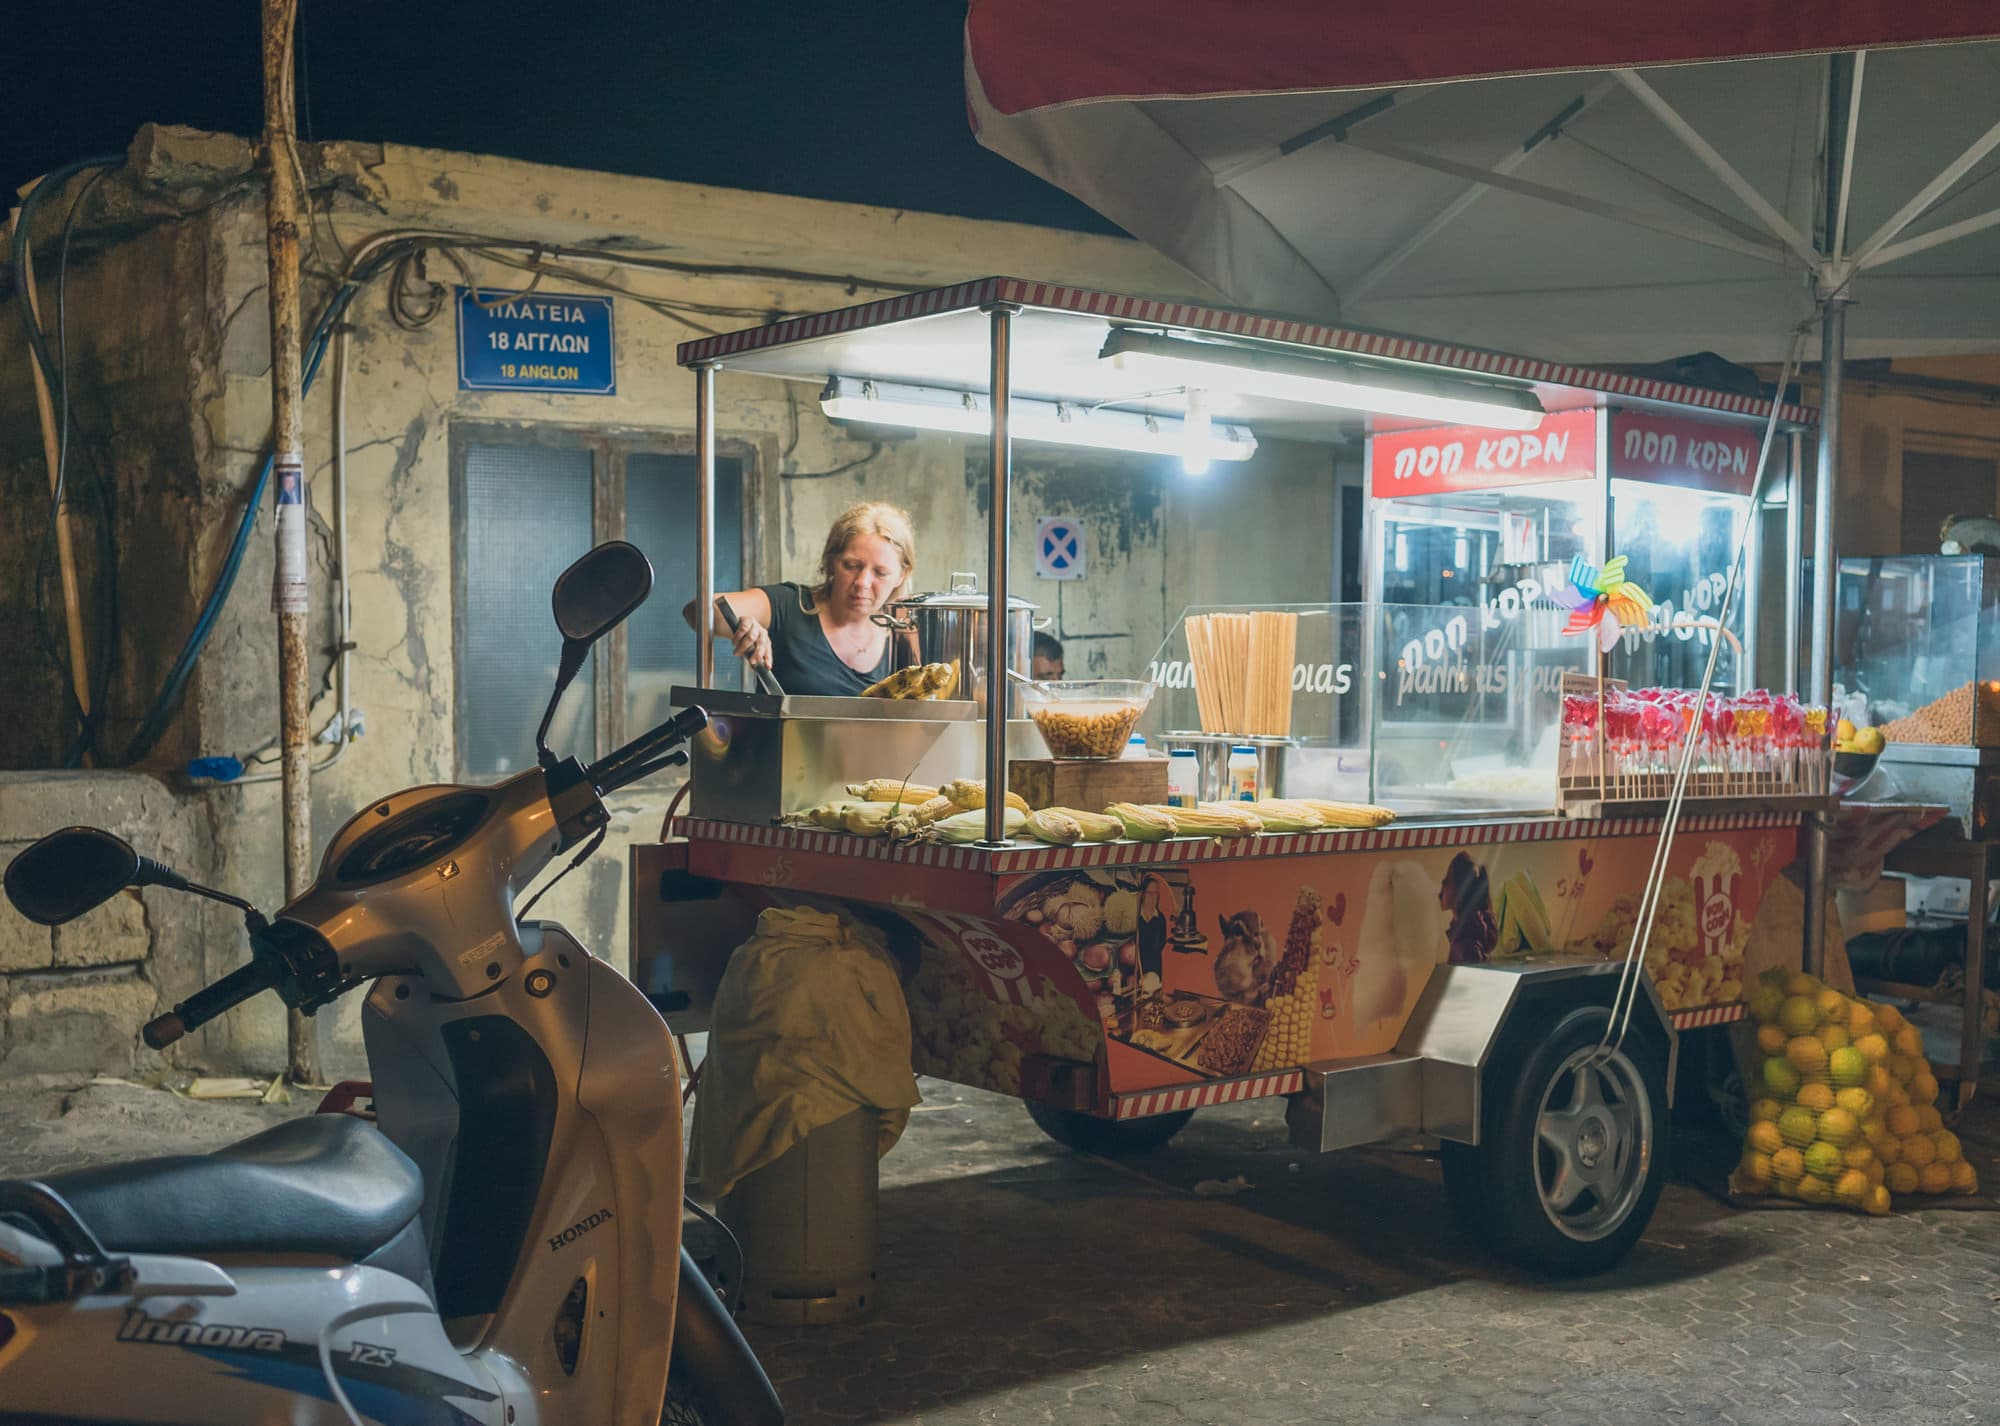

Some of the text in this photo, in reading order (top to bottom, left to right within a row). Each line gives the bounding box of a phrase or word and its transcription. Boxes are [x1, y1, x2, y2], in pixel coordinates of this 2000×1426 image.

[488, 303, 586, 323] ΠΛΑΤΕΙΑ
[488, 331, 589, 354] 18 ΑΓΓΛΩΝ
[501, 364, 579, 380] 18 ANGLON
[547, 1208, 614, 1252] HONDA
[117, 1306, 397, 1368] Innova 125
